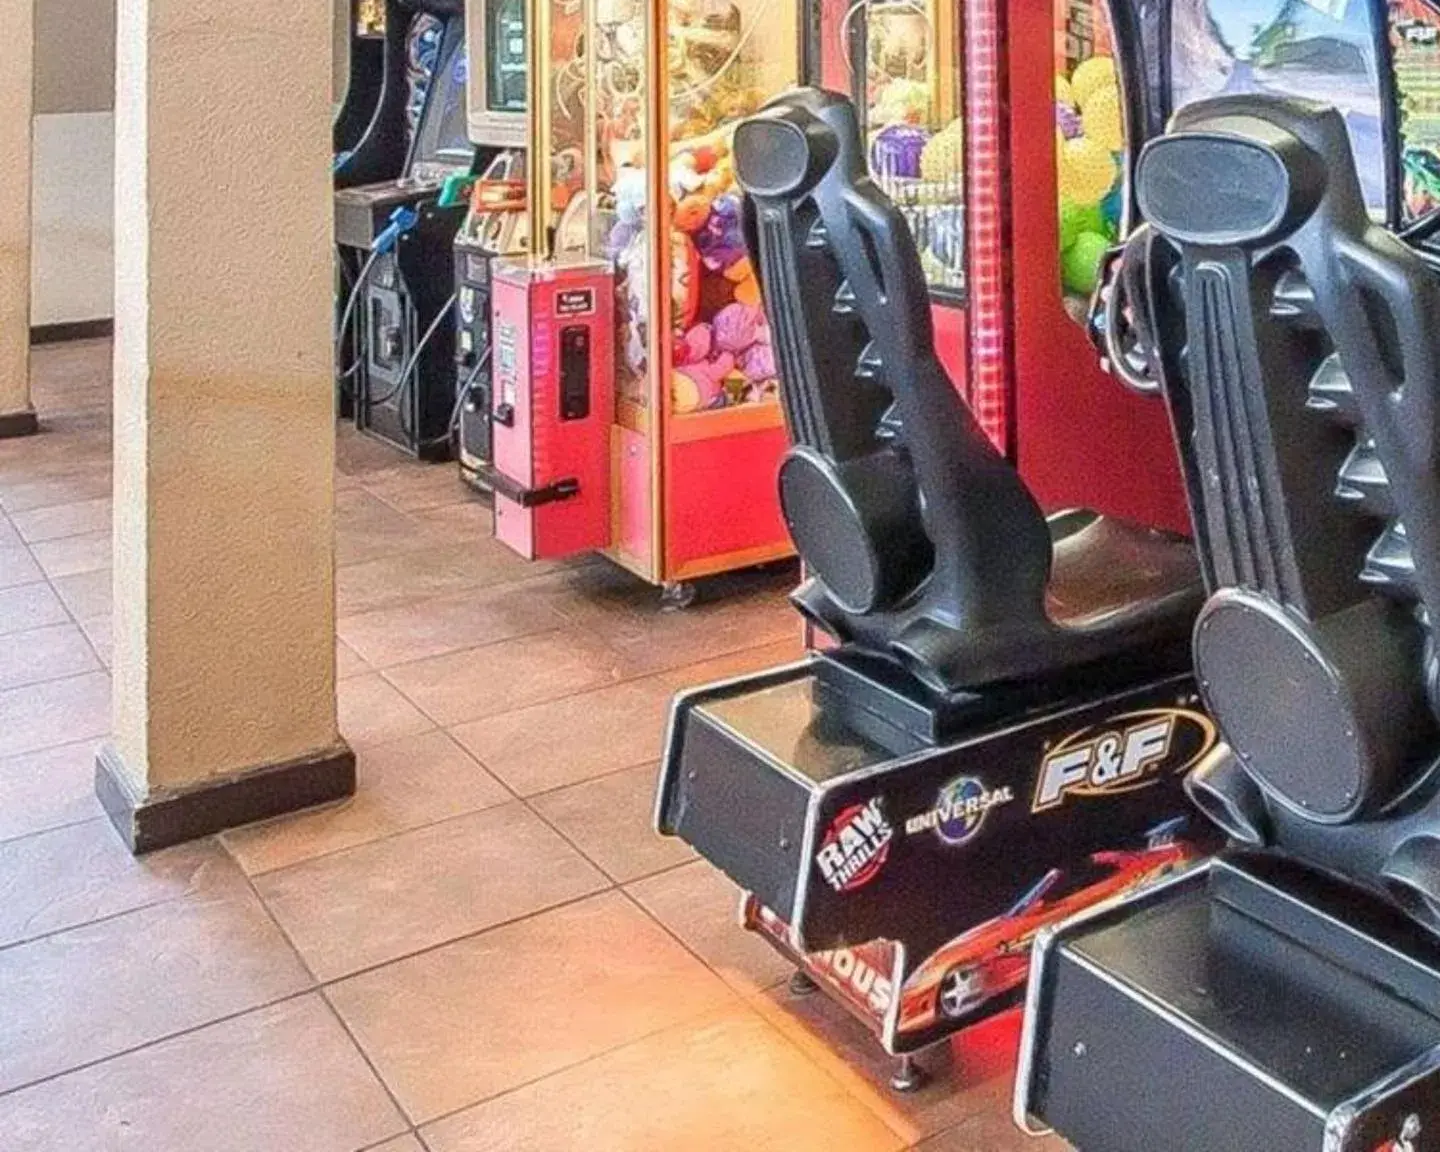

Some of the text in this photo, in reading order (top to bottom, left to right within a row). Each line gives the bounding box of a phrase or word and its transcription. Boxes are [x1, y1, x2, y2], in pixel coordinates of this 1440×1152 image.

[1035, 718, 1172, 807] F&F
[816, 797, 885, 879] RAW
[905, 784, 1015, 835] UNIVERSAL
[828, 821, 894, 892] THRILLS
